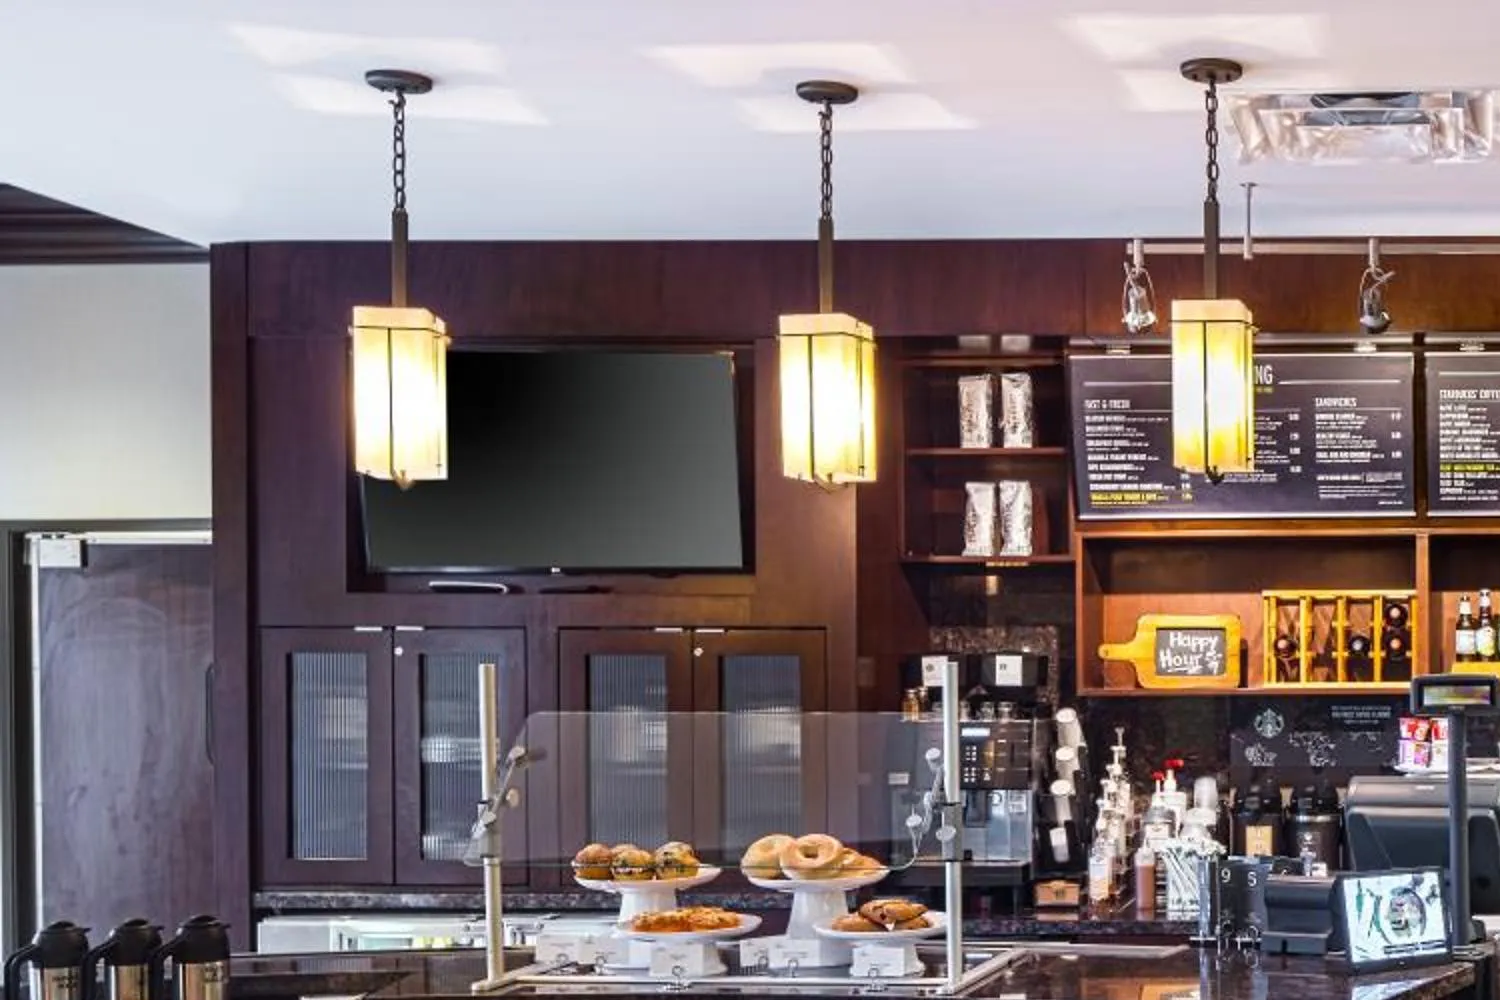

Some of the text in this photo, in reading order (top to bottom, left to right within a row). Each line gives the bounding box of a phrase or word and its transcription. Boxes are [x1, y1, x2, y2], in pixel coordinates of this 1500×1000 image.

[1169, 631, 1219, 652] Happy
[1159, 648, 1203, 669] Hour
[1220, 867, 1231, 883] 9
